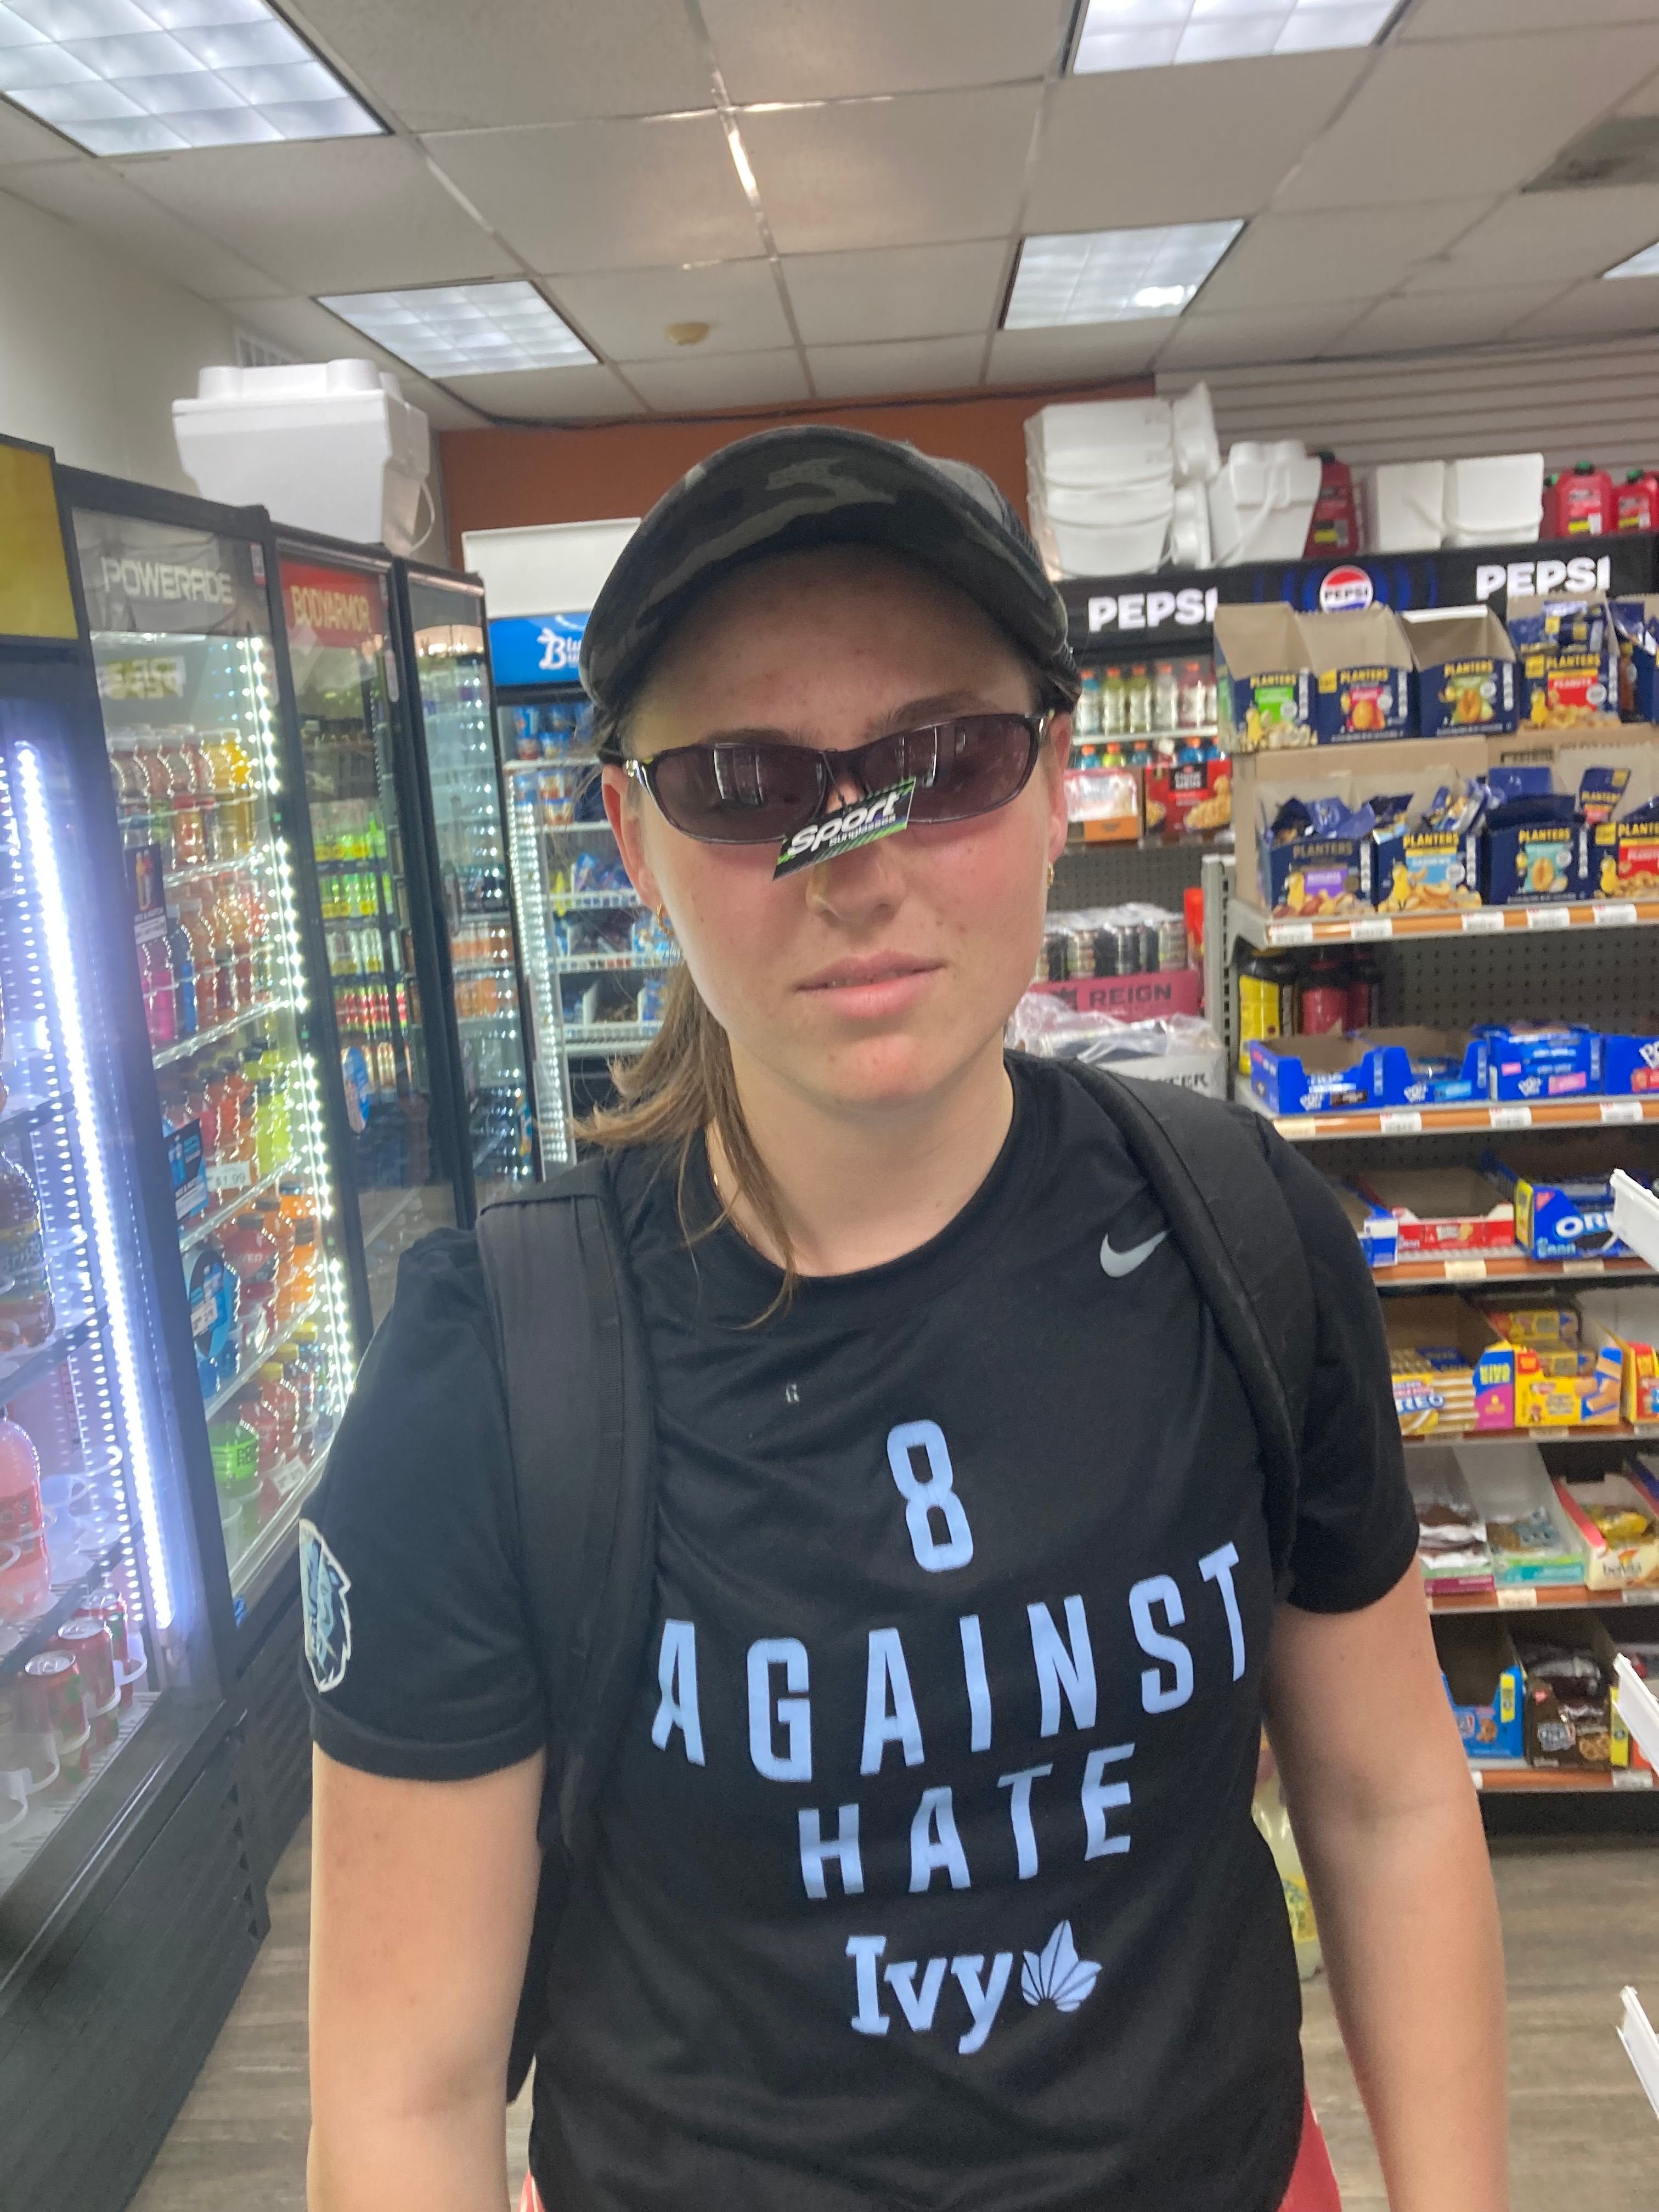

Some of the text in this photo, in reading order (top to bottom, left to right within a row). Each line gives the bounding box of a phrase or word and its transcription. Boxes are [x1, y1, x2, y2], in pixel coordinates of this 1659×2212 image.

[101, 556, 236, 604] POWERADE
[1325, 588, 1369, 600] PEPSI
[1476, 555, 1611, 601] PEPSI
[290, 585, 370, 633] BODYARMOR
[1088, 586, 1218, 633] PEPSI
[1547, 653, 1601, 670] PLANTERS
[1403, 832, 1459, 848] PLANTERS
[1519, 827, 1571, 843] PLANTERS
[1089, 982, 1172, 1008] REIGN
[886, 1419, 974, 1572] 8
[651, 1542, 1246, 1782] AGAINST
[798, 1743, 1136, 1899] HATE
[845, 1936, 1013, 2055] Ivy
